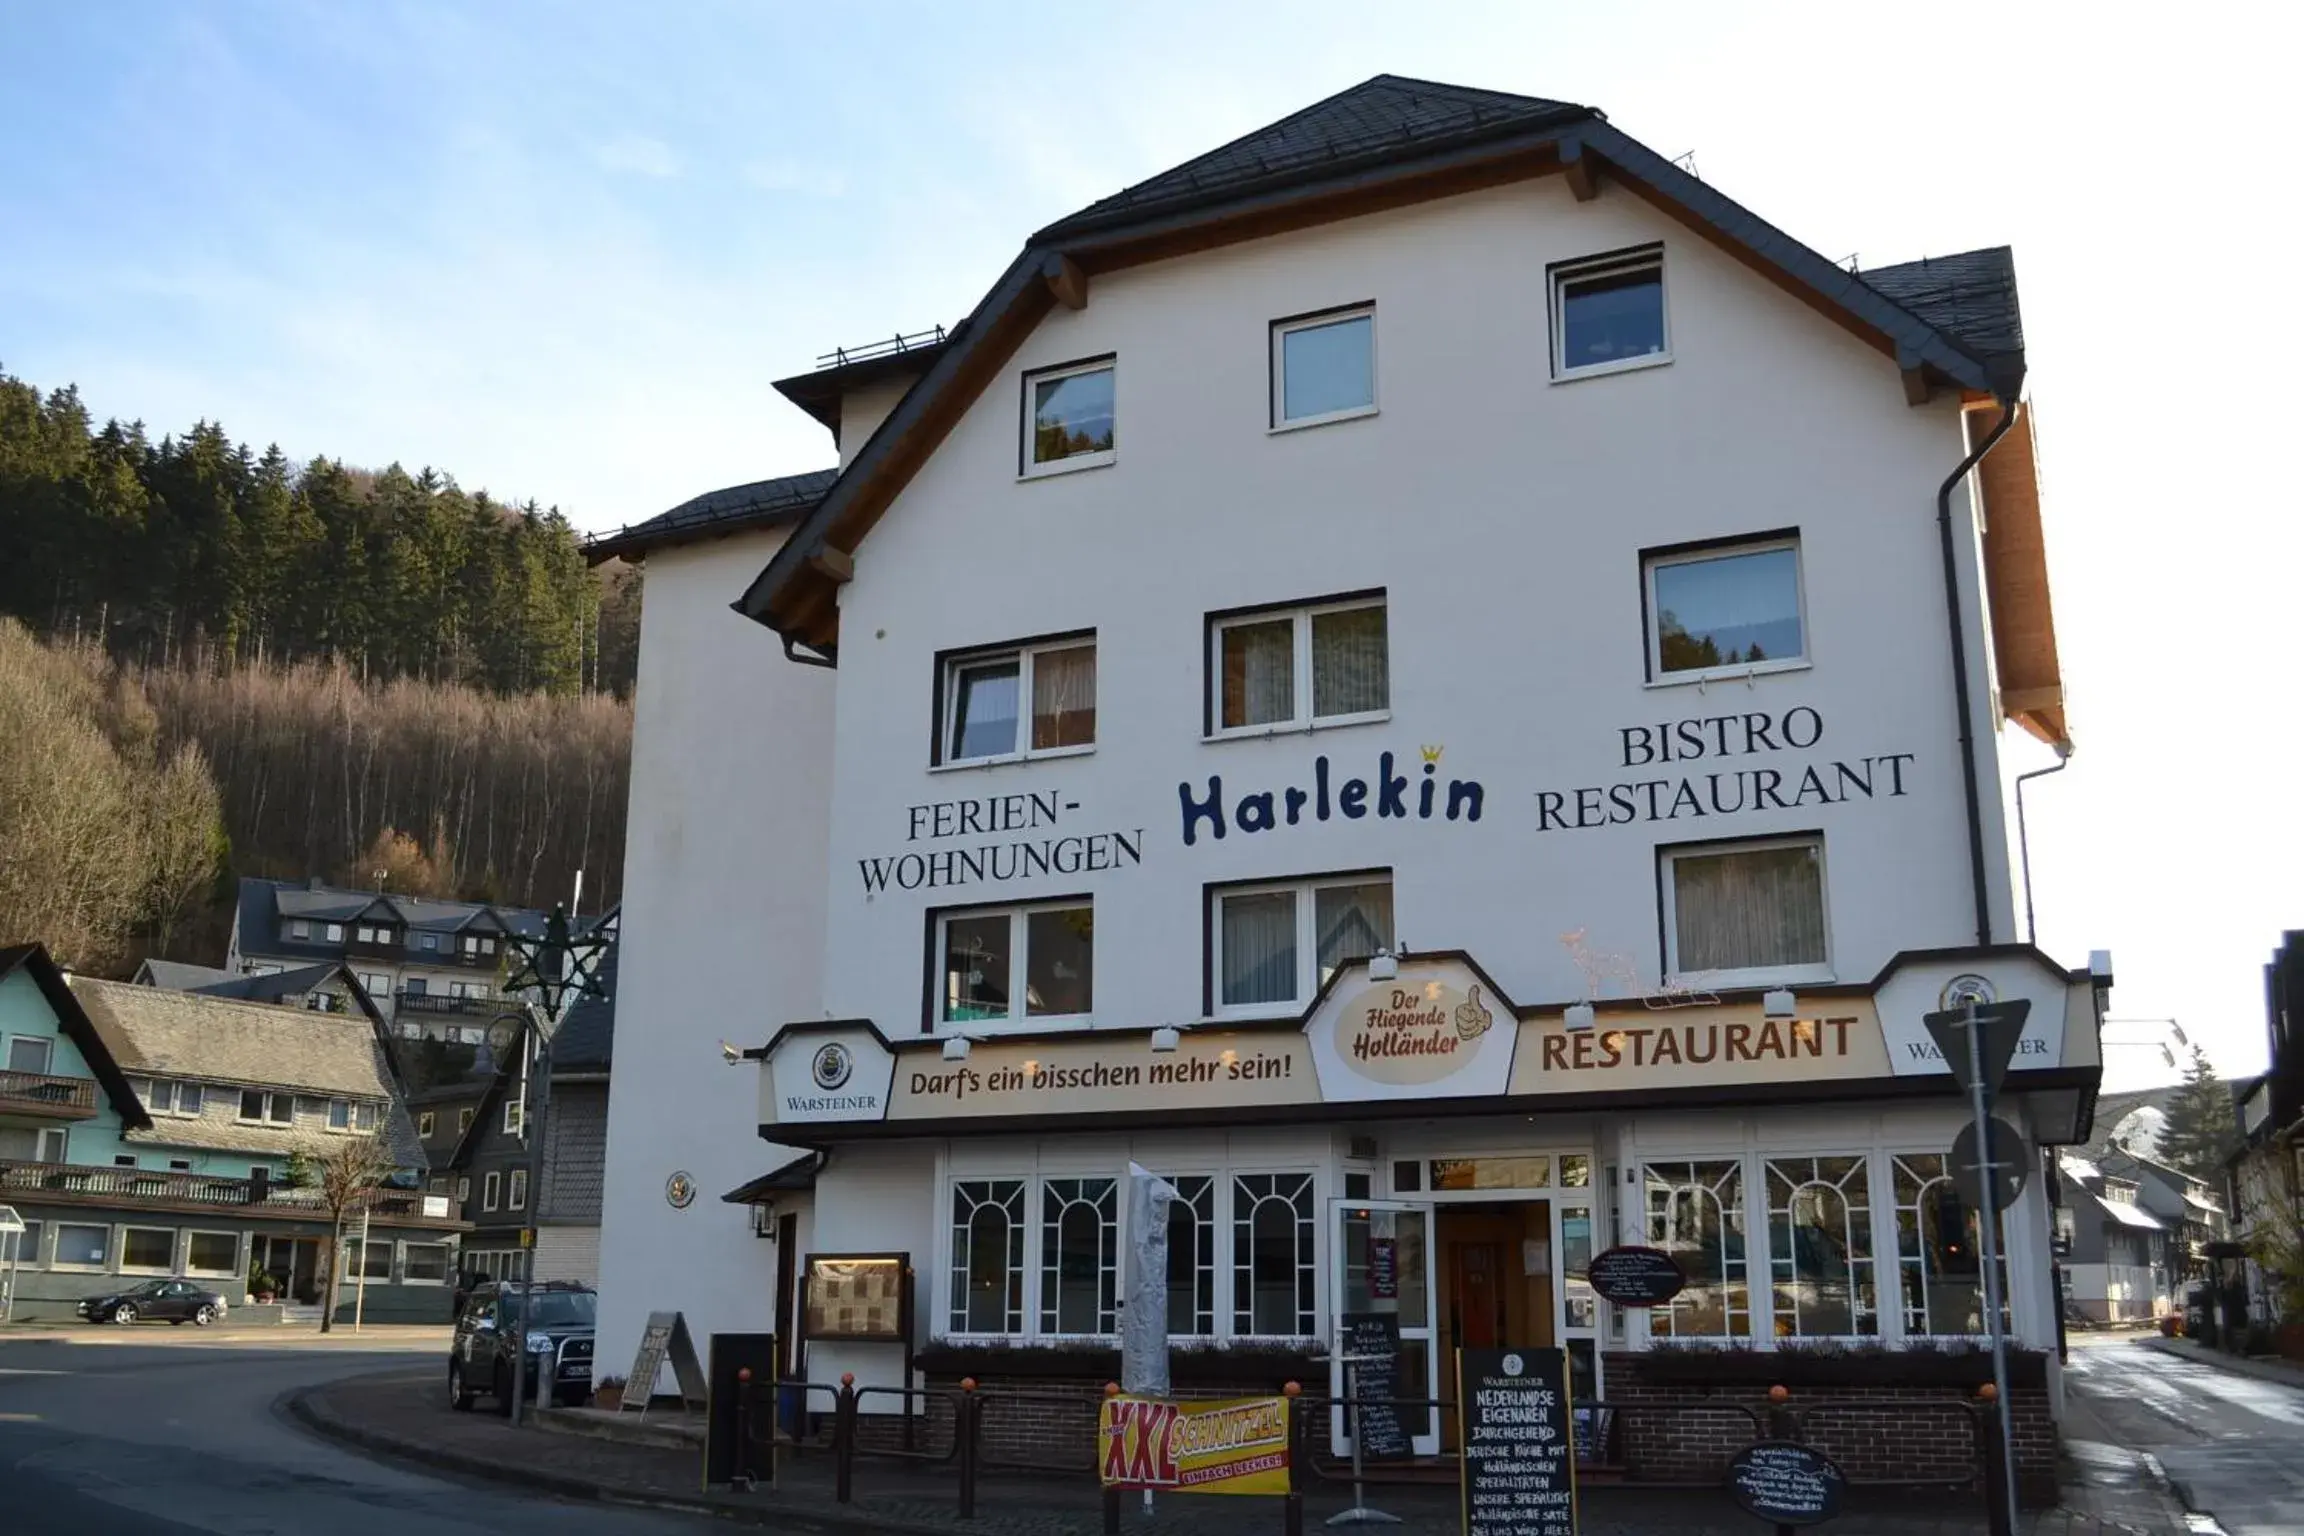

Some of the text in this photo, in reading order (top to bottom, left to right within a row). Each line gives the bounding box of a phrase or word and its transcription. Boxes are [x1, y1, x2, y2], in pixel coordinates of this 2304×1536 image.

[1619, 705, 1825, 768] BISTRO
[906, 789, 1080, 841] FERIEN-
[1178, 751, 1484, 847] Harlekin
[1535, 753, 1915, 832] RESTAURANT
[858, 828, 1145, 893] WOHNUNGEN
[1366, 1006, 1446, 1032] Fliegende
[1390, 989, 1420, 1010] Der
[1352, 1030, 1459, 1062] Holländer
[1542, 1016, 1858, 1071] RESTAURANT
[910, 1054, 1291, 1098] Darf's ein bisschen mehr sein!
[787, 1096, 877, 1111] WARSTEINER
[1101, 1399, 1180, 1484] XXL
[1168, 1400, 1285, 1460] SCHNITZEL
[1183, 1463, 1231, 1484] EINFACH
